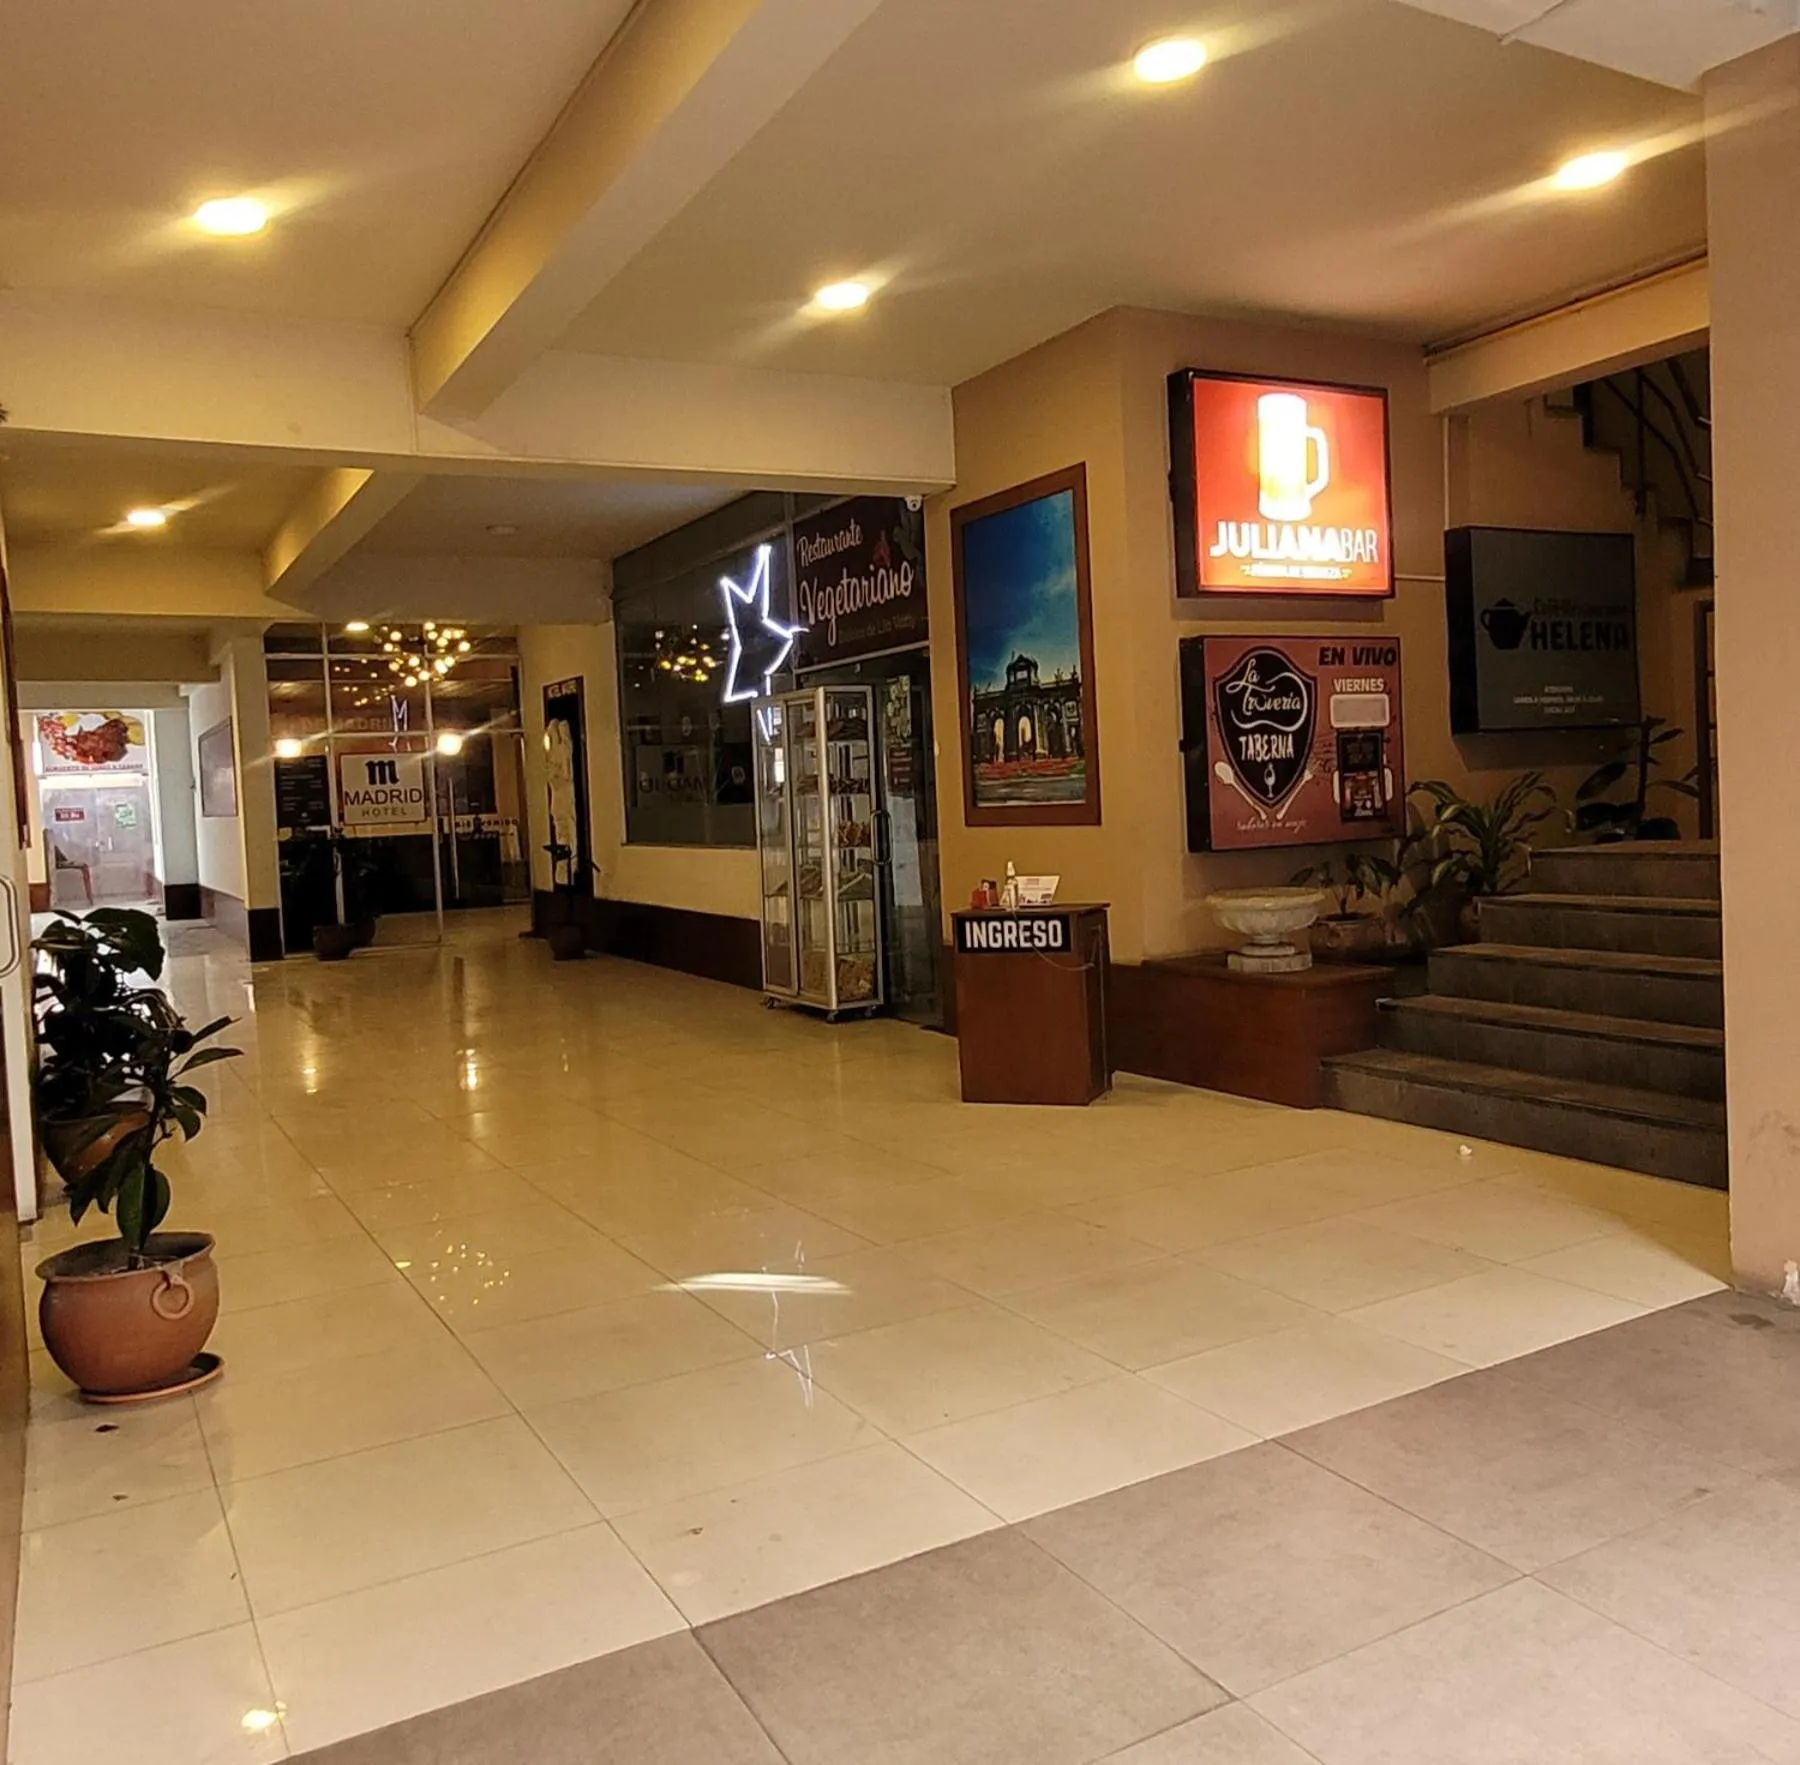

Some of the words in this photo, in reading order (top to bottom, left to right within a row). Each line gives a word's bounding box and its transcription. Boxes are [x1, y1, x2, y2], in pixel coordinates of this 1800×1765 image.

[797, 516, 863, 568] Restaurante
[800, 560, 914, 647] Vegetariano
[1530, 620, 1630, 651] HELENA
[1318, 647, 1345, 666] EN
[1352, 646, 1397, 666] VIVO
[1333, 678, 1385, 693] VIERNES
[1238, 732, 1295, 762] TABERNA
[344, 788, 424, 806] MADRID
[361, 806, 408, 818] HOTEL
[964, 919, 1063, 949] INGRESO
